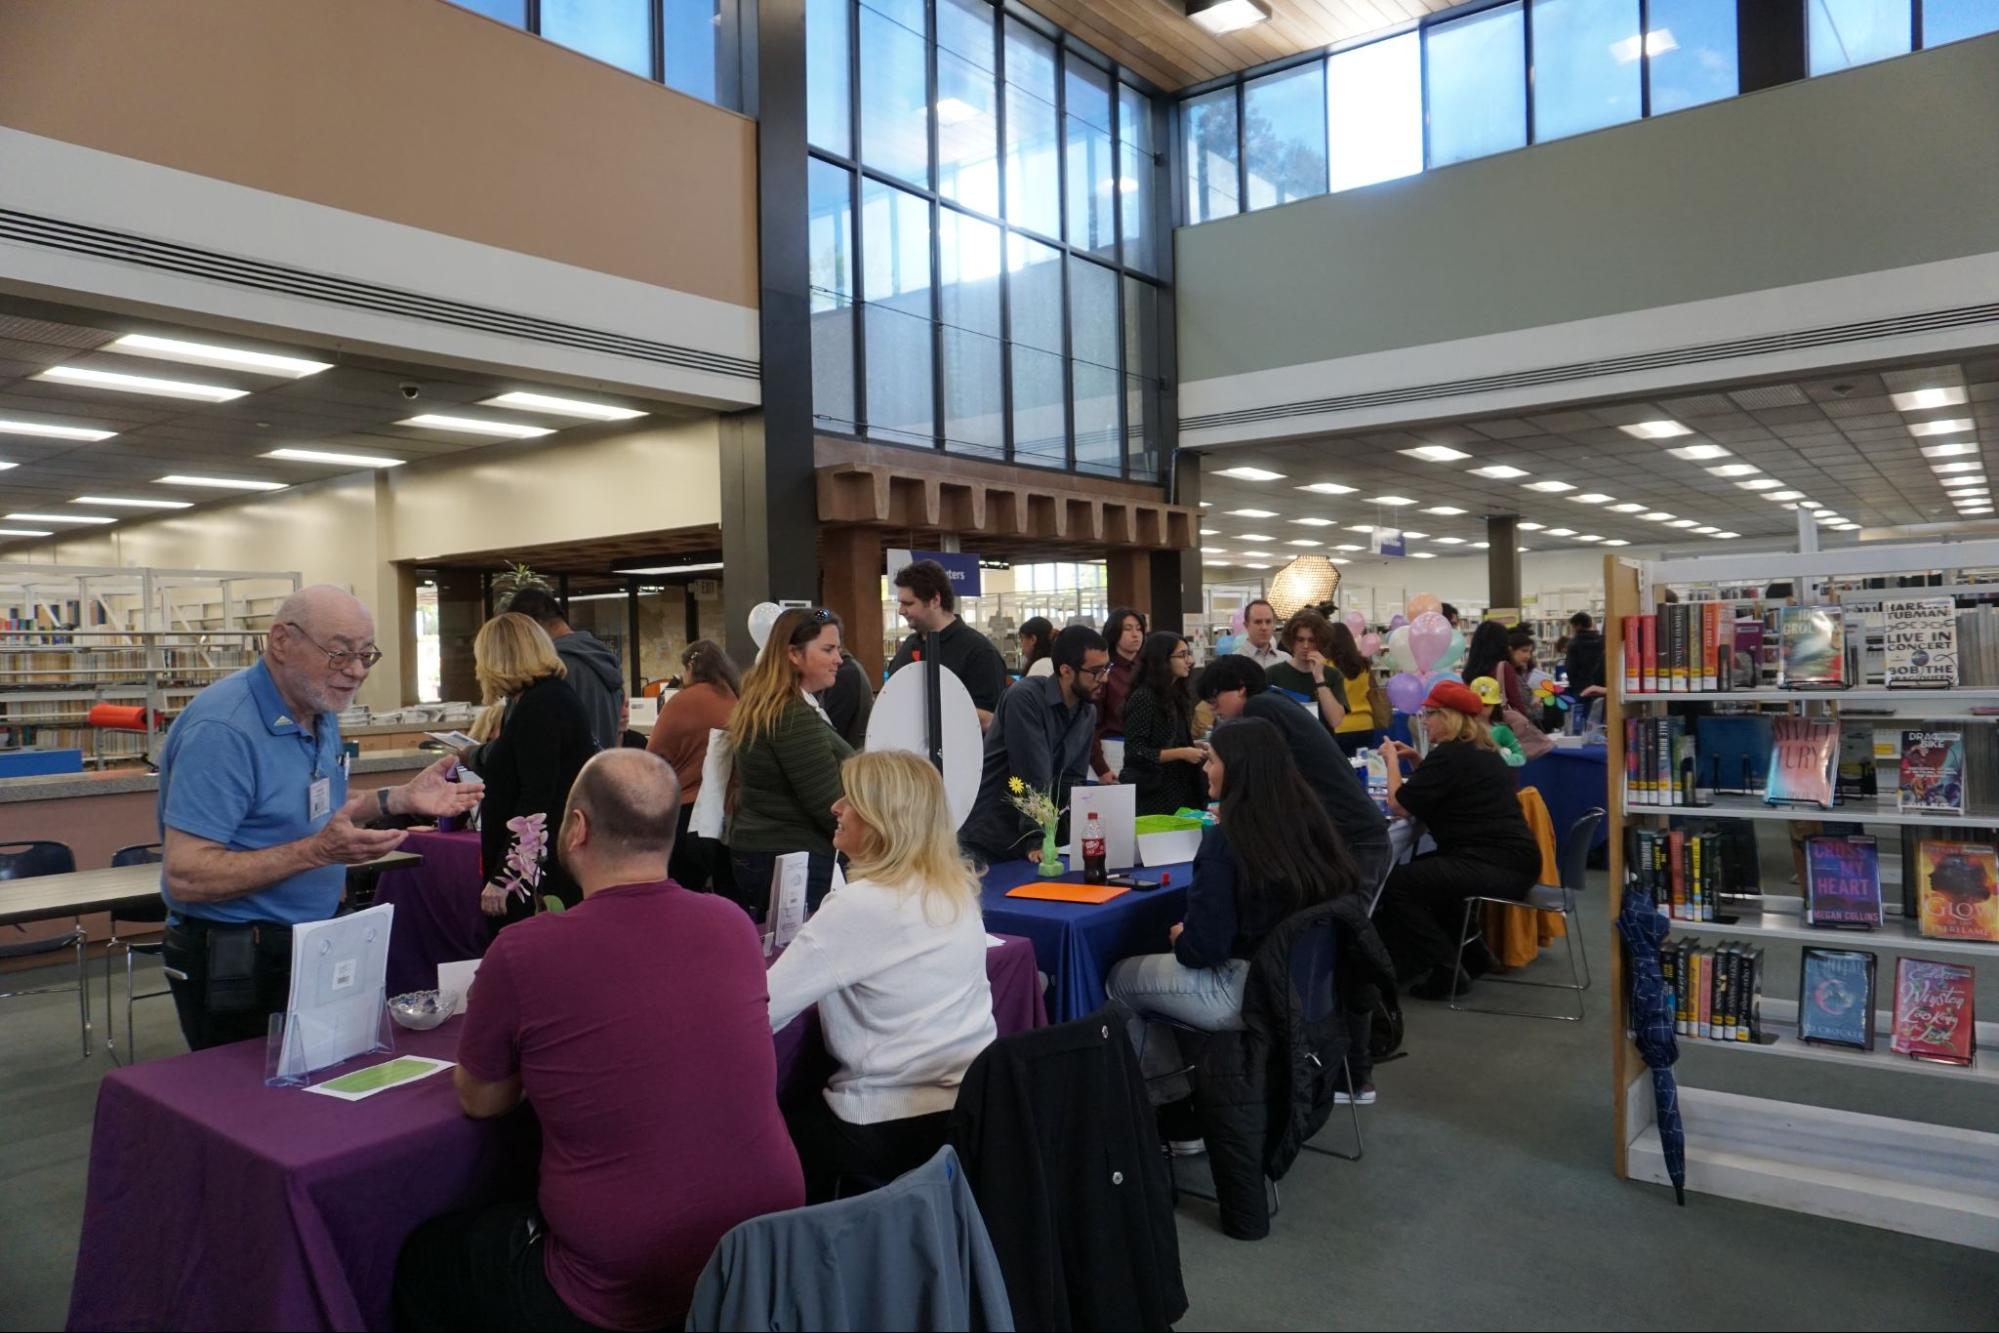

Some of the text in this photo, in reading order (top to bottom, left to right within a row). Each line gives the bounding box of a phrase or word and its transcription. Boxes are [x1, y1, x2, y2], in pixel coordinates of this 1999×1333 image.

[1888, 632, 1951, 643] LIVE IN
[1888, 642, 1952, 651] CONCERT
[1926, 665, 1953, 674] THE
[1921, 740, 1945, 748] BIKE
[1814, 841, 1865, 859] CROSS
[1840, 860, 1863, 876] MY
[1817, 878, 1869, 896] HEART
[1844, 911, 1880, 922] COLLINS
